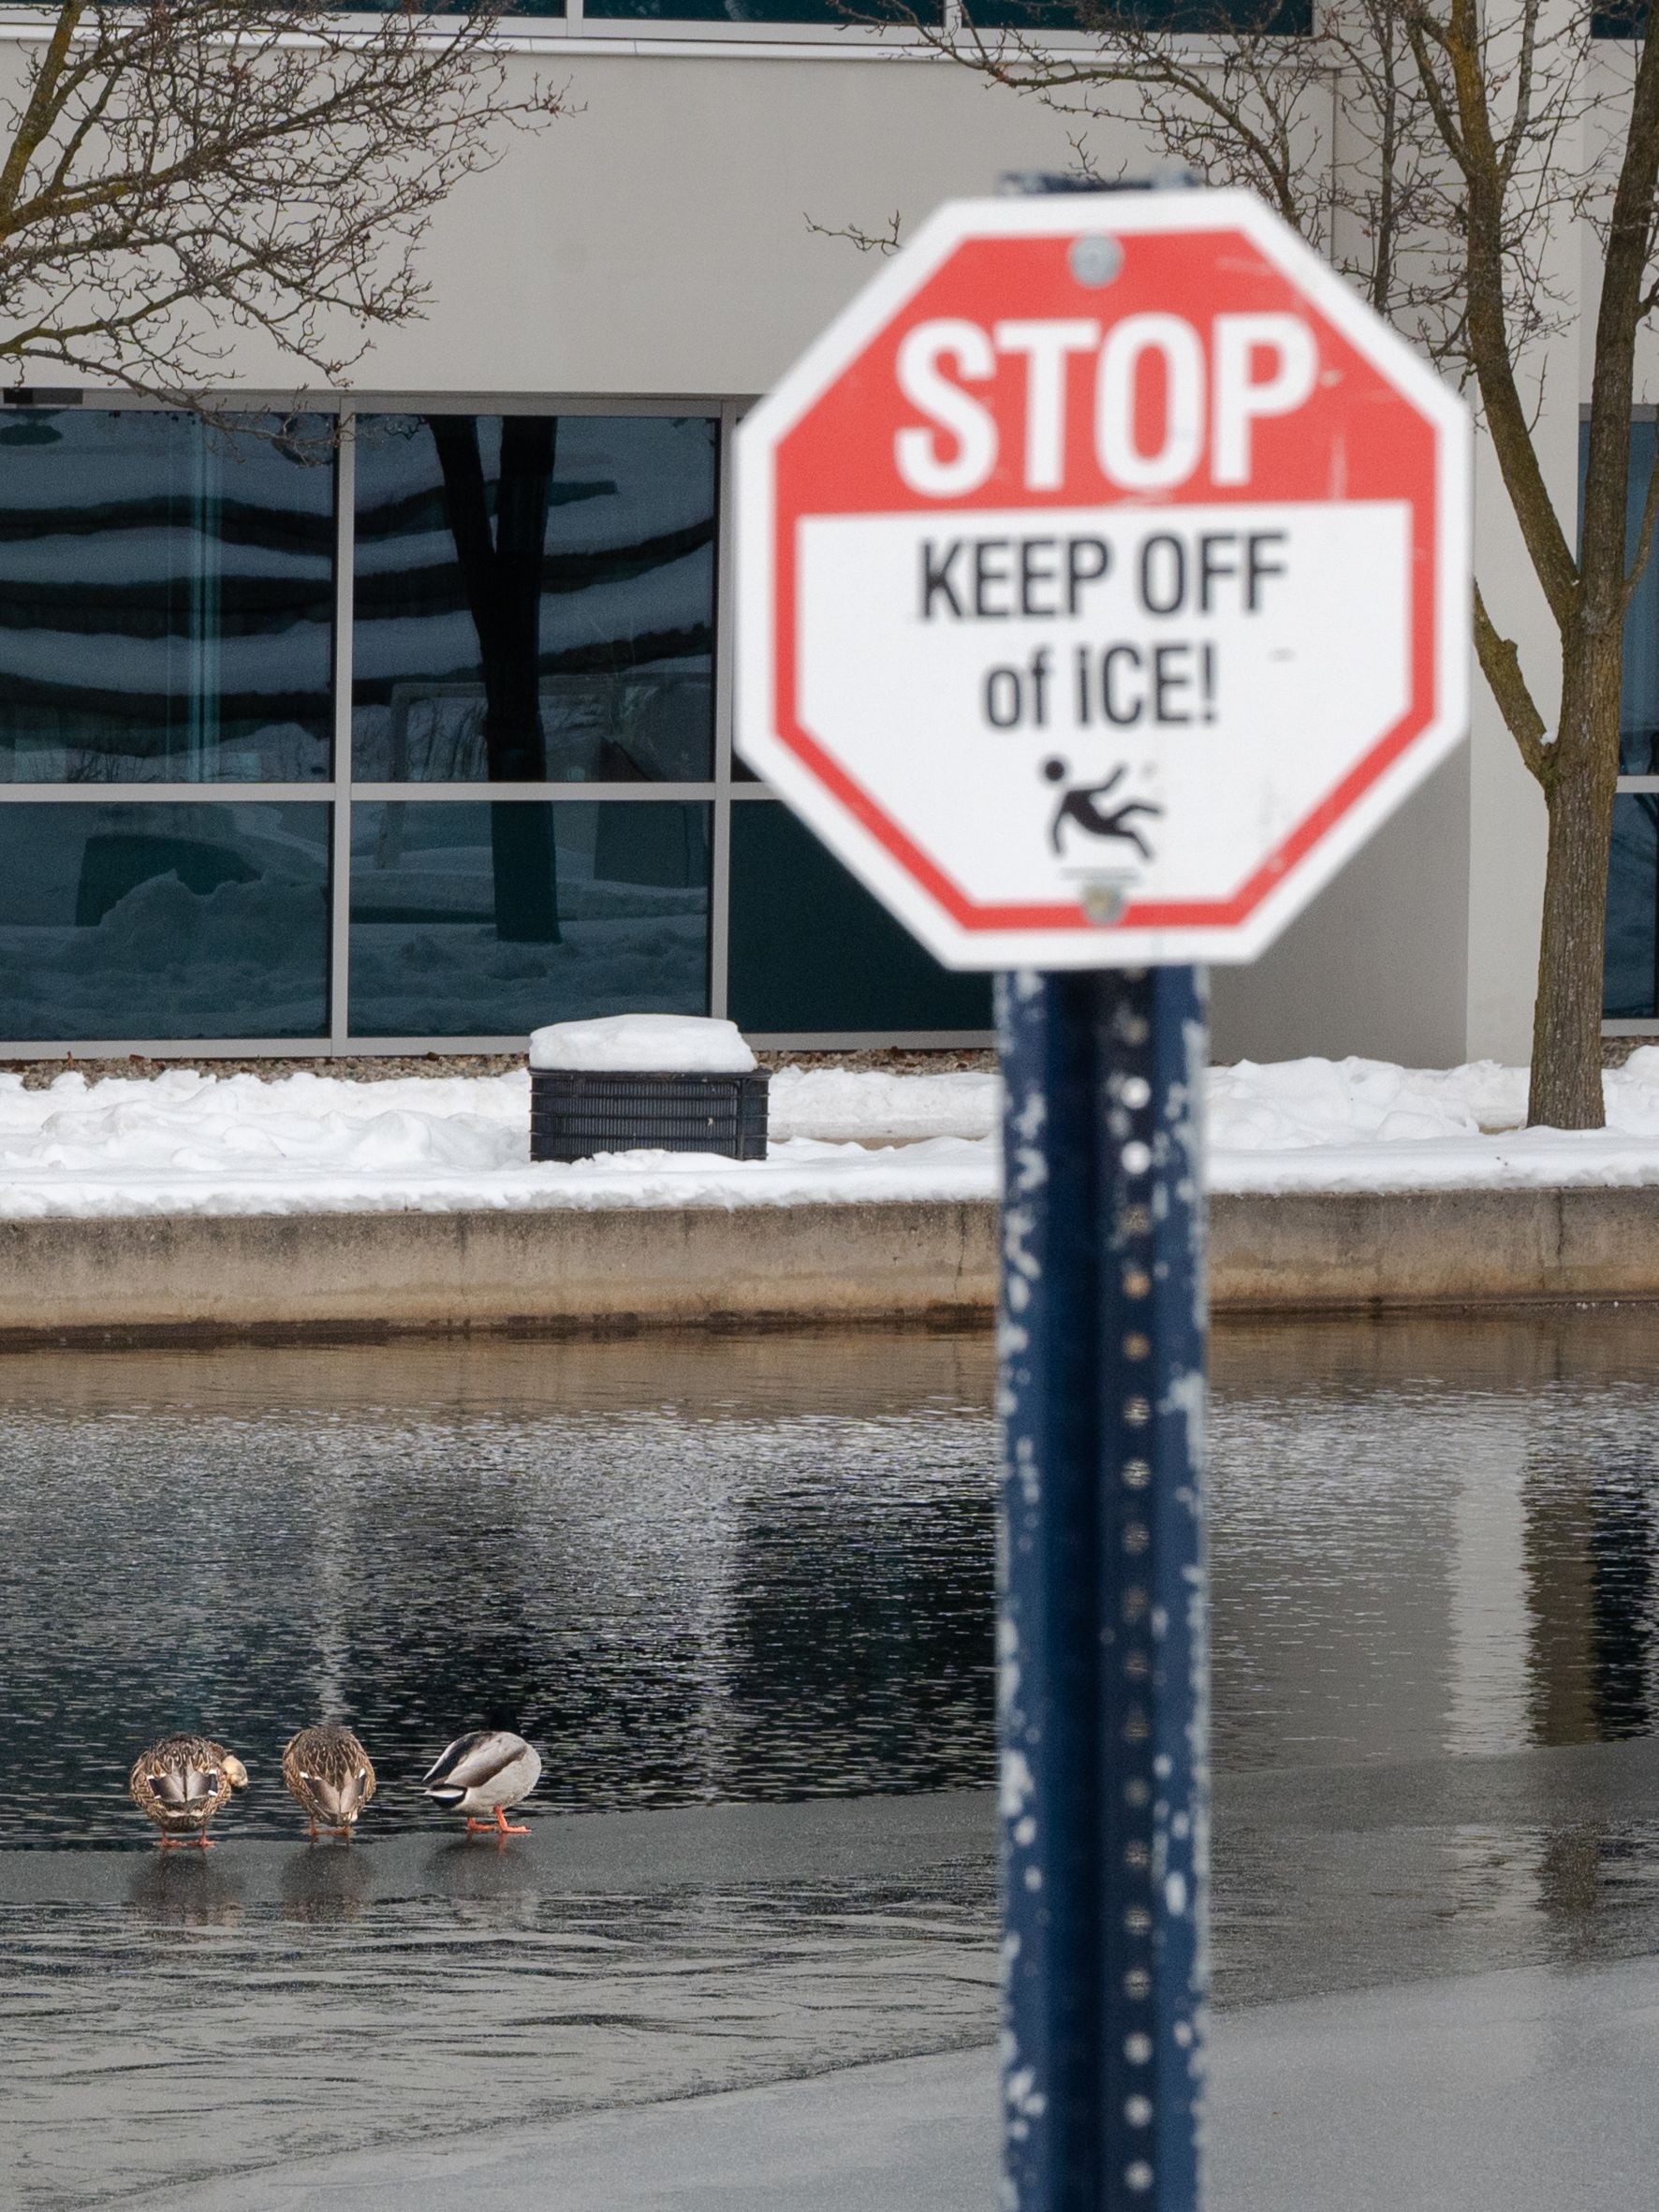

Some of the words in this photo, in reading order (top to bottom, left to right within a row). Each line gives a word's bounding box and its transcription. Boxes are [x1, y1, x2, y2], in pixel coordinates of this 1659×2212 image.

[895, 313, 1319, 499] STOP
[921, 537, 1111, 621] KEEP
[1139, 532, 1287, 617] OFF
[983, 645, 1051, 730] of
